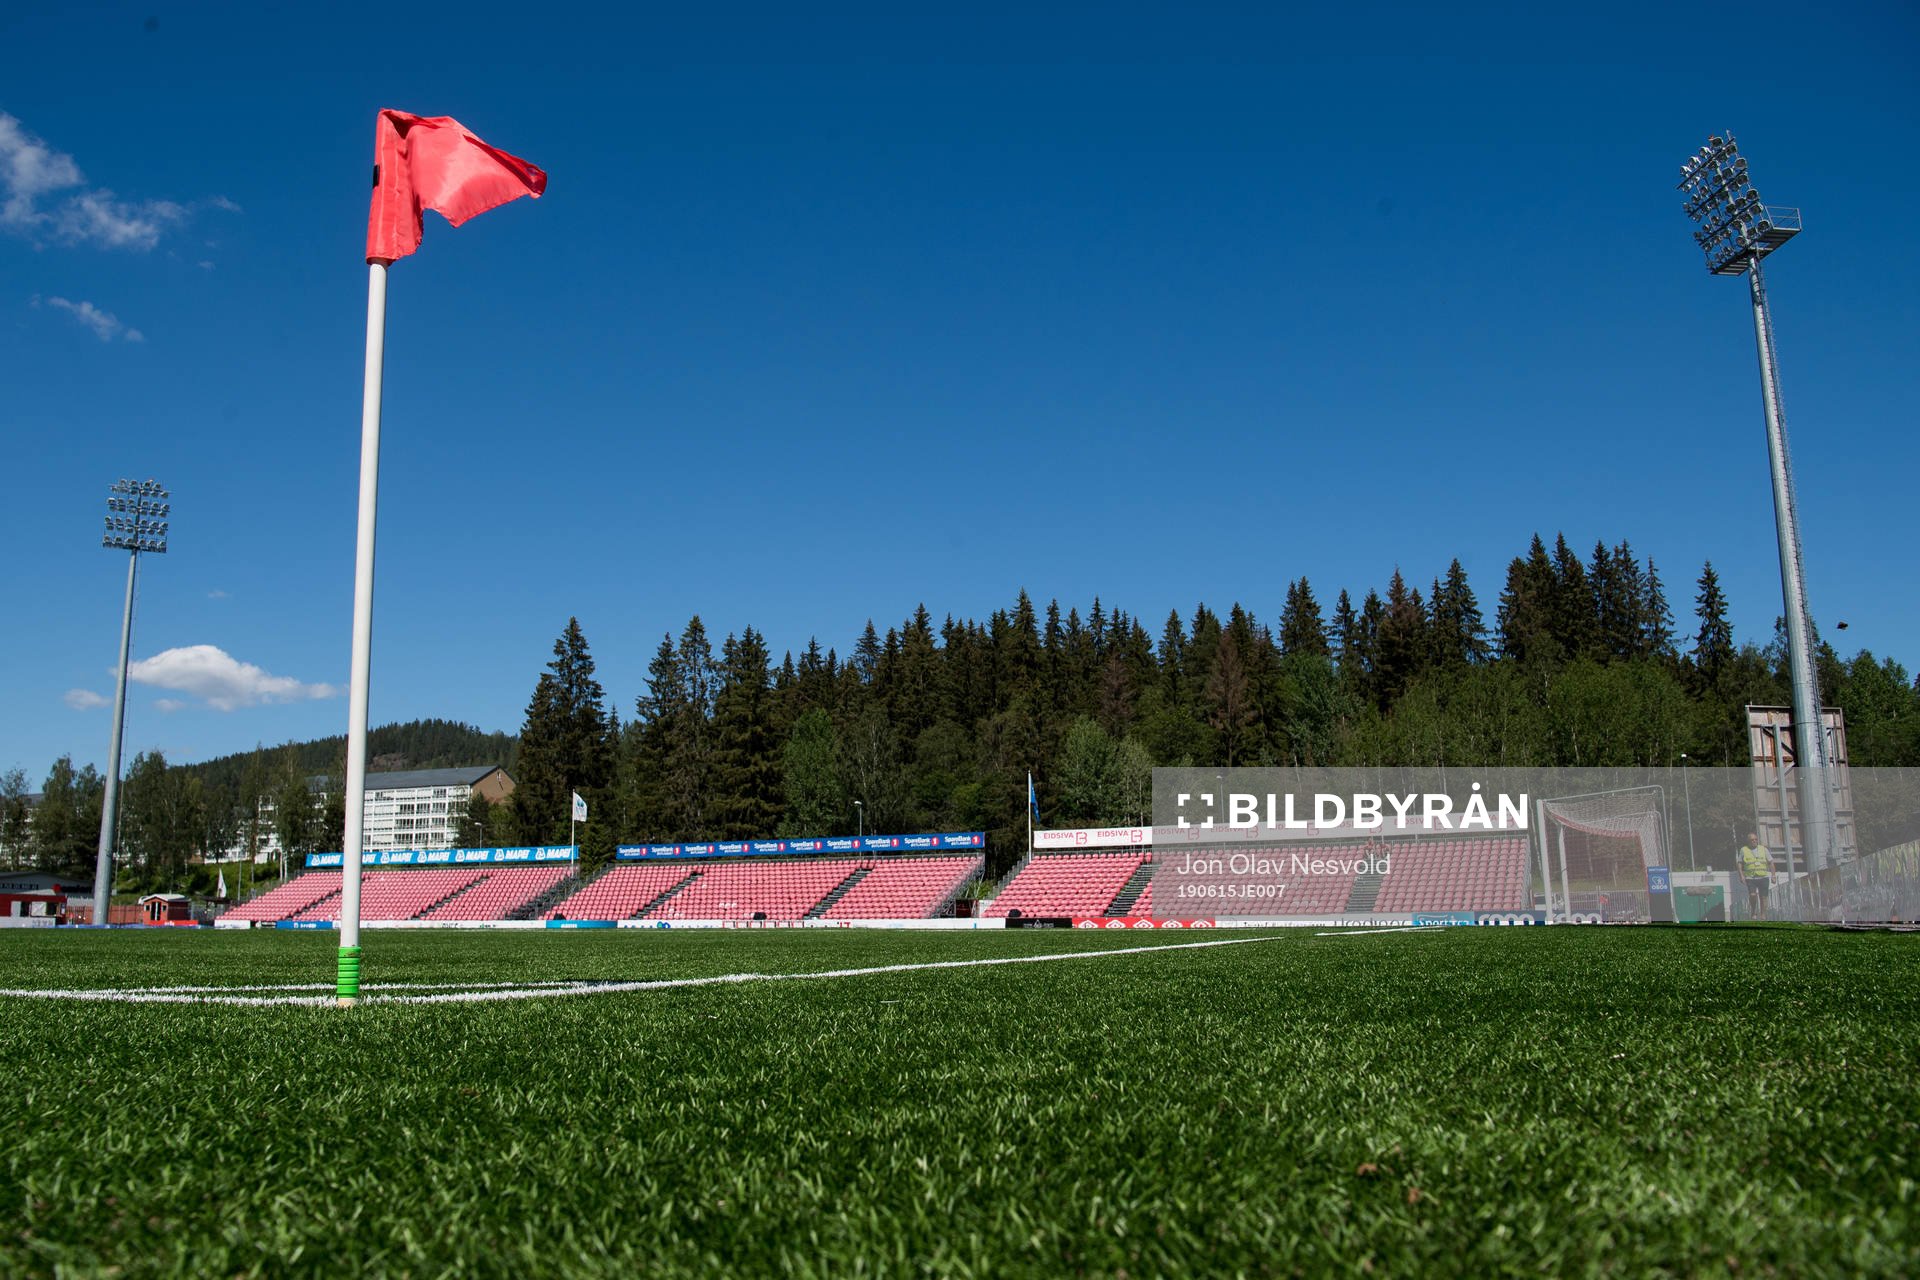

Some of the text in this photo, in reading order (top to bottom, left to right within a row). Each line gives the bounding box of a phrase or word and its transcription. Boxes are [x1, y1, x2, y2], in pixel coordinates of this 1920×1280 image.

[1043, 832, 1074, 840] EIDSIVA
[1097, 830, 1129, 838] EIDSIVA
[465, 851, 489, 860] MAPEI
[505, 849, 530, 859] MAPEI
[546, 848, 572, 858] MAPEI
